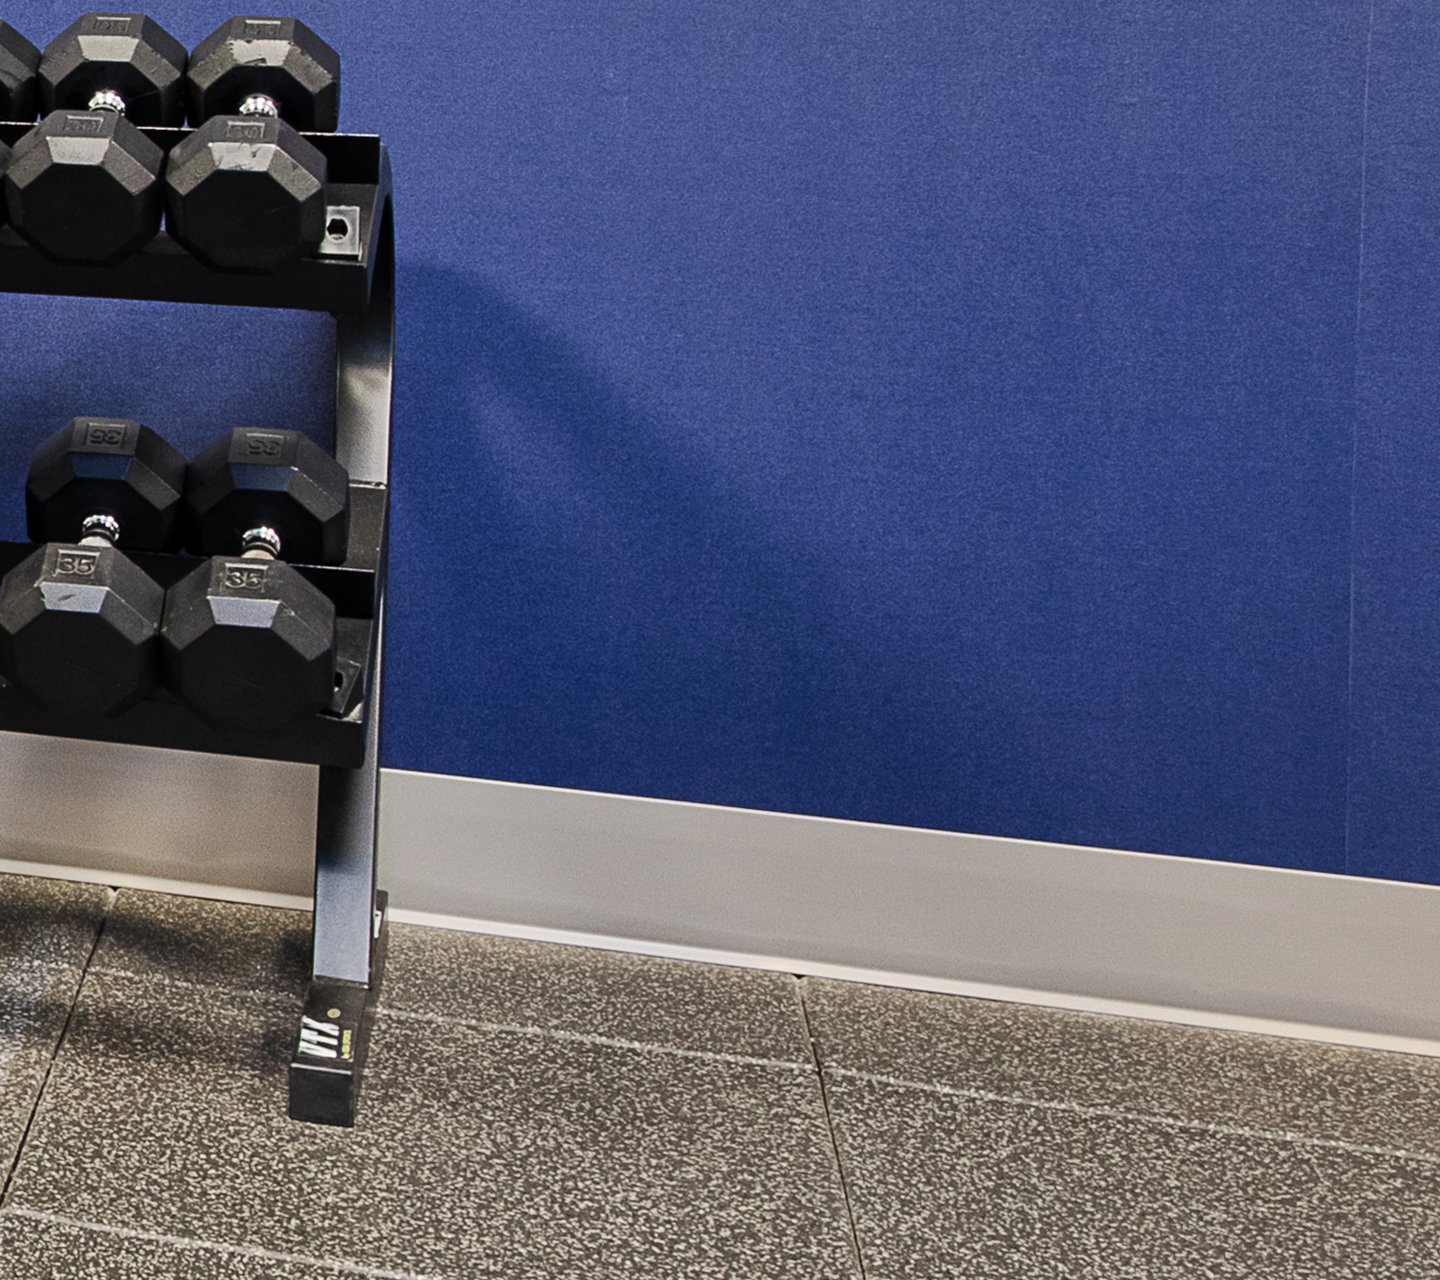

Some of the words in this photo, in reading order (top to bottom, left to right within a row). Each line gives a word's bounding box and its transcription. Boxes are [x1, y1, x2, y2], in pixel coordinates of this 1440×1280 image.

[89, 428, 122, 446] 35
[58, 556, 95, 576] 35
[225, 571, 264, 589] 35
